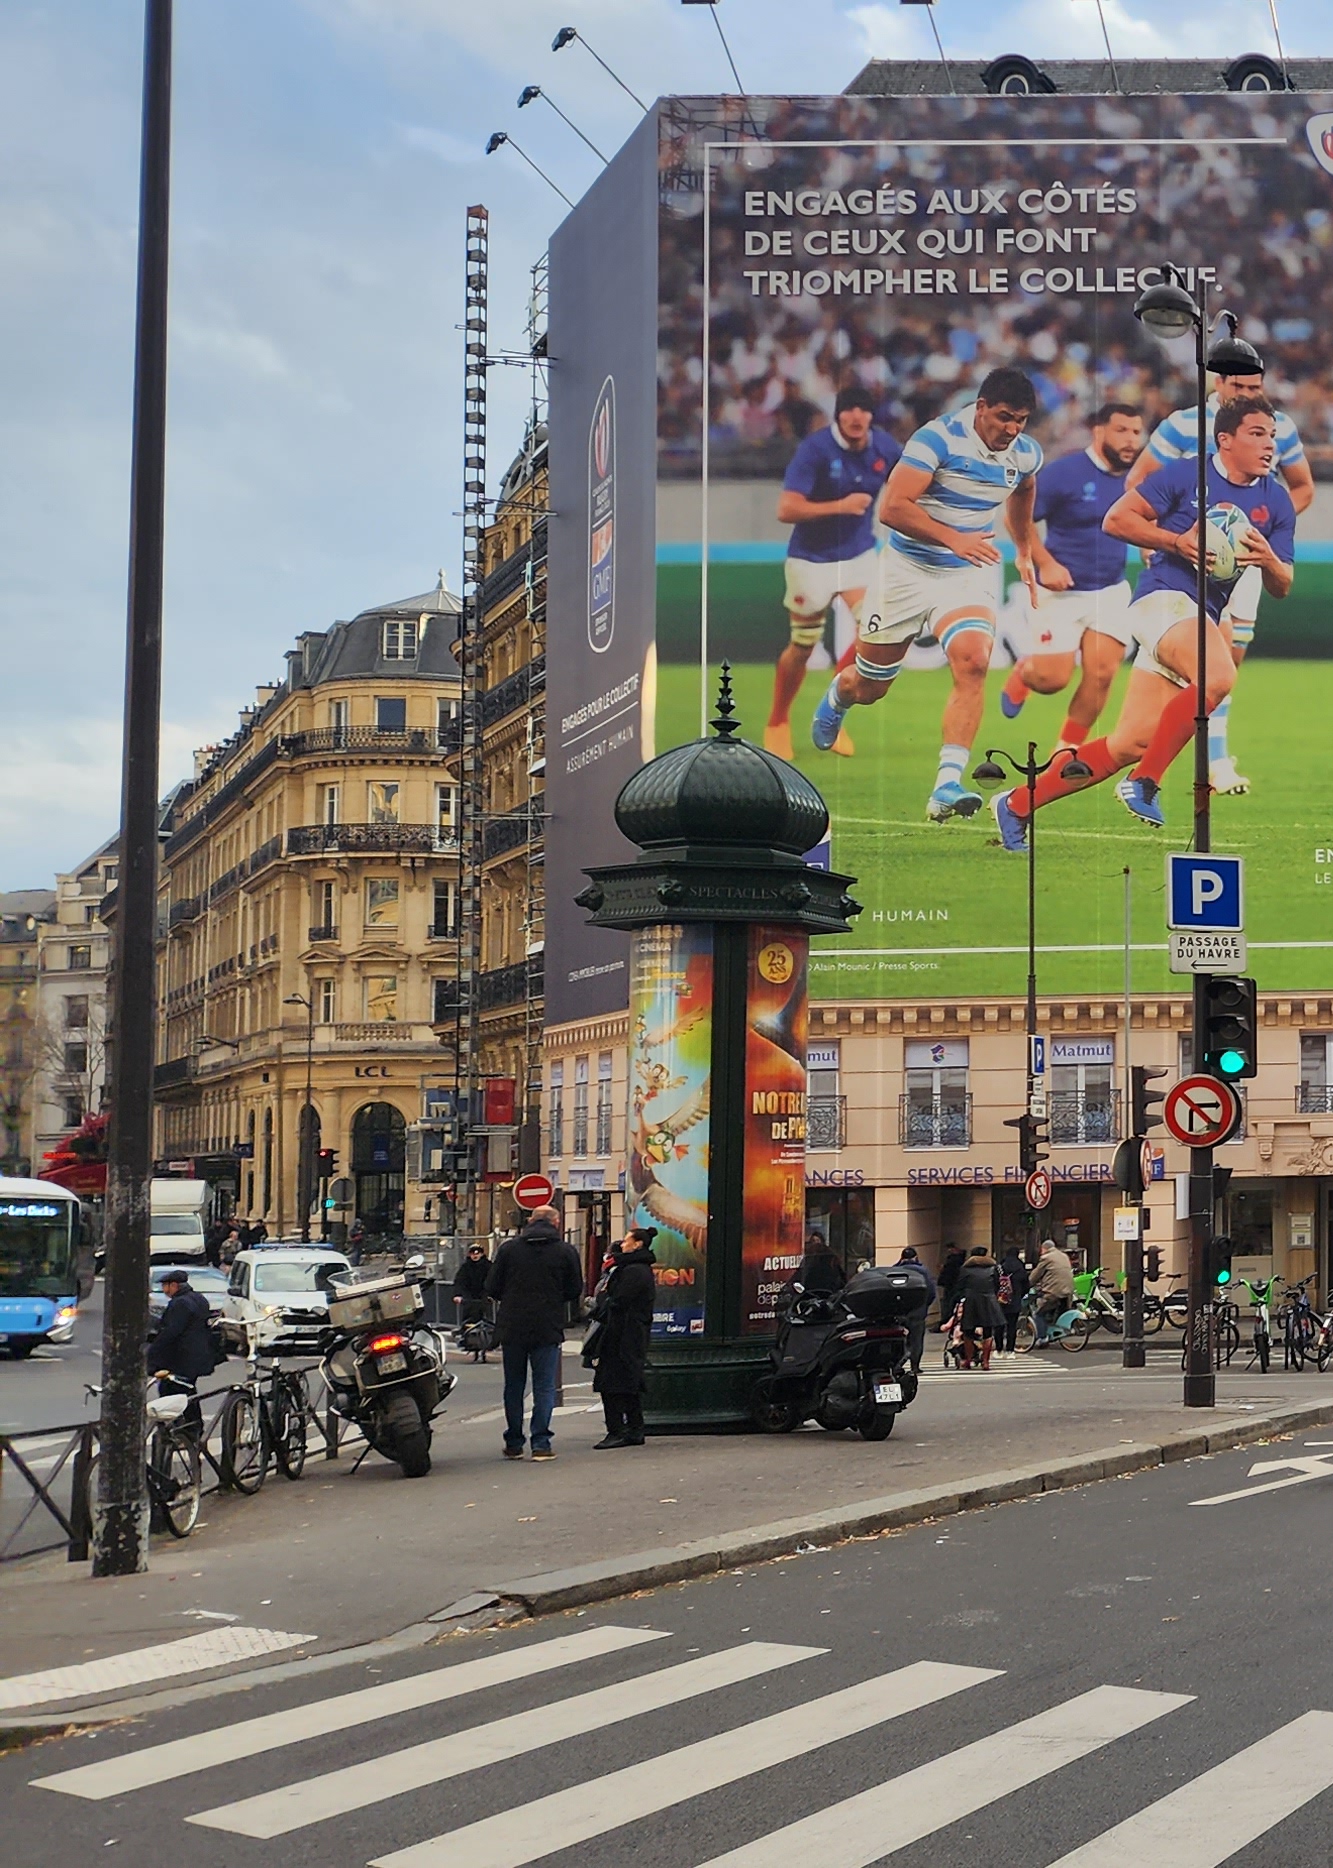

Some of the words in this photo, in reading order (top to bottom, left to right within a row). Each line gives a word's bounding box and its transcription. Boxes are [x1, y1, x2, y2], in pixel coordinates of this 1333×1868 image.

[744, 182, 917, 216] ENGAGÉS
[926, 189, 1008, 214] AUX
[1018, 180, 1138, 214] CÔTÉS
[744, 230, 792, 256] DE
[803, 229, 907, 255] CEUX
[916, 228, 984, 259] QUI
[996, 227, 1097, 254] FONT
[743, 268, 958, 296] TRIOMPHER
[969, 268, 1009, 294] LE
[868, 614, 881, 633] 6
[1315, 873, 1331, 884] LE
[688, 885, 780, 899] SPECTACLES
[1191, 869, 1224, 915] P
[872, 909, 948, 922] HUMAIN
[1179, 937, 1238, 947] PASSAGE
[767, 950, 786, 966] 25
[1177, 948, 1193, 959] DU
[1198, 948, 1241, 959] HAVRE
[768, 964, 787, 975] ANS
[813, 963, 836, 971] Alain
[837, 962, 870, 971] Mounic
[878, 961, 907, 970] Presse
[807, 1049, 838, 1064] mut
[1052, 1044, 1111, 1057] Matmut
[355, 1066, 394, 1078] LCL
[771, 1122, 788, 1139] DE
[804, 1169, 864, 1186] ANCES
[907, 1167, 994, 1185] SERVICES
